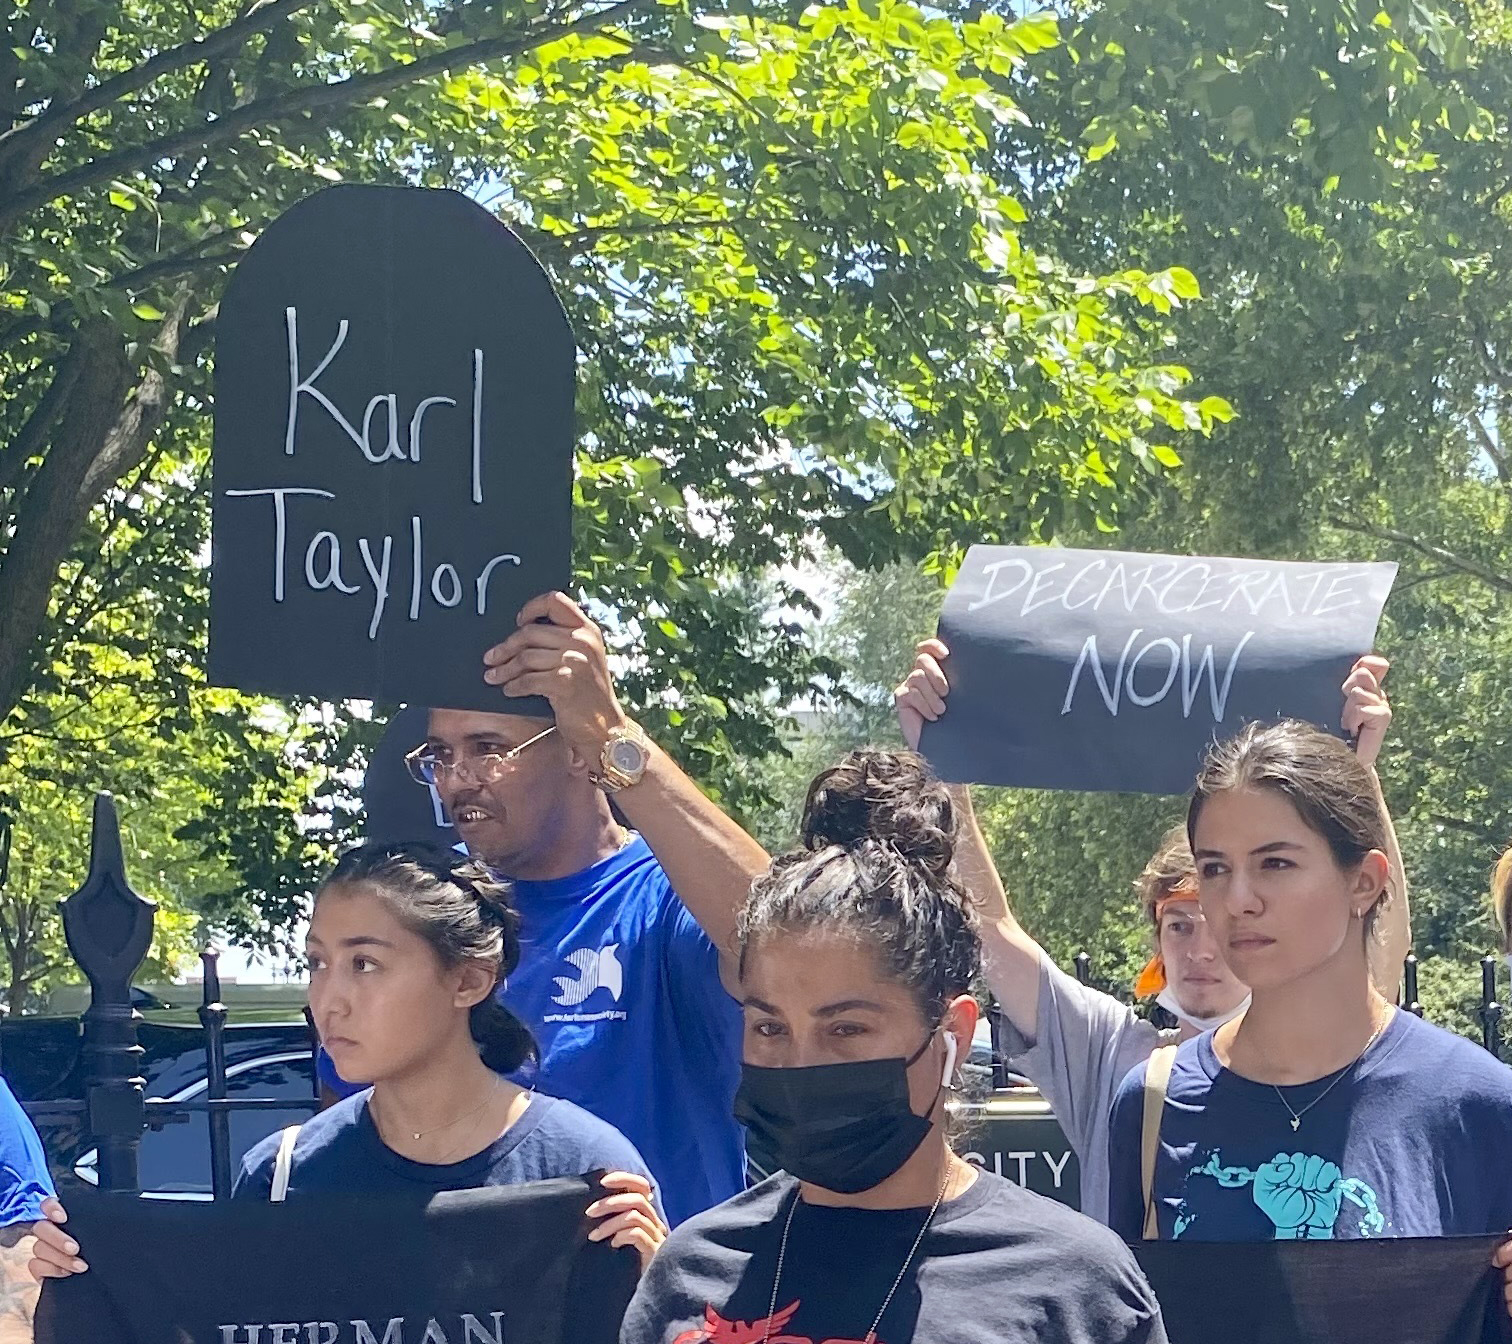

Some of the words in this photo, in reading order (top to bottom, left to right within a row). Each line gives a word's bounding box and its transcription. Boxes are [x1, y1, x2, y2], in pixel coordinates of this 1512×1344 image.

[285, 306, 483, 503] Karl
[225, 487, 520, 640] Taylor
[968, 558, 1370, 617] DECARCERATE
[1061, 628, 1255, 723] NOW
